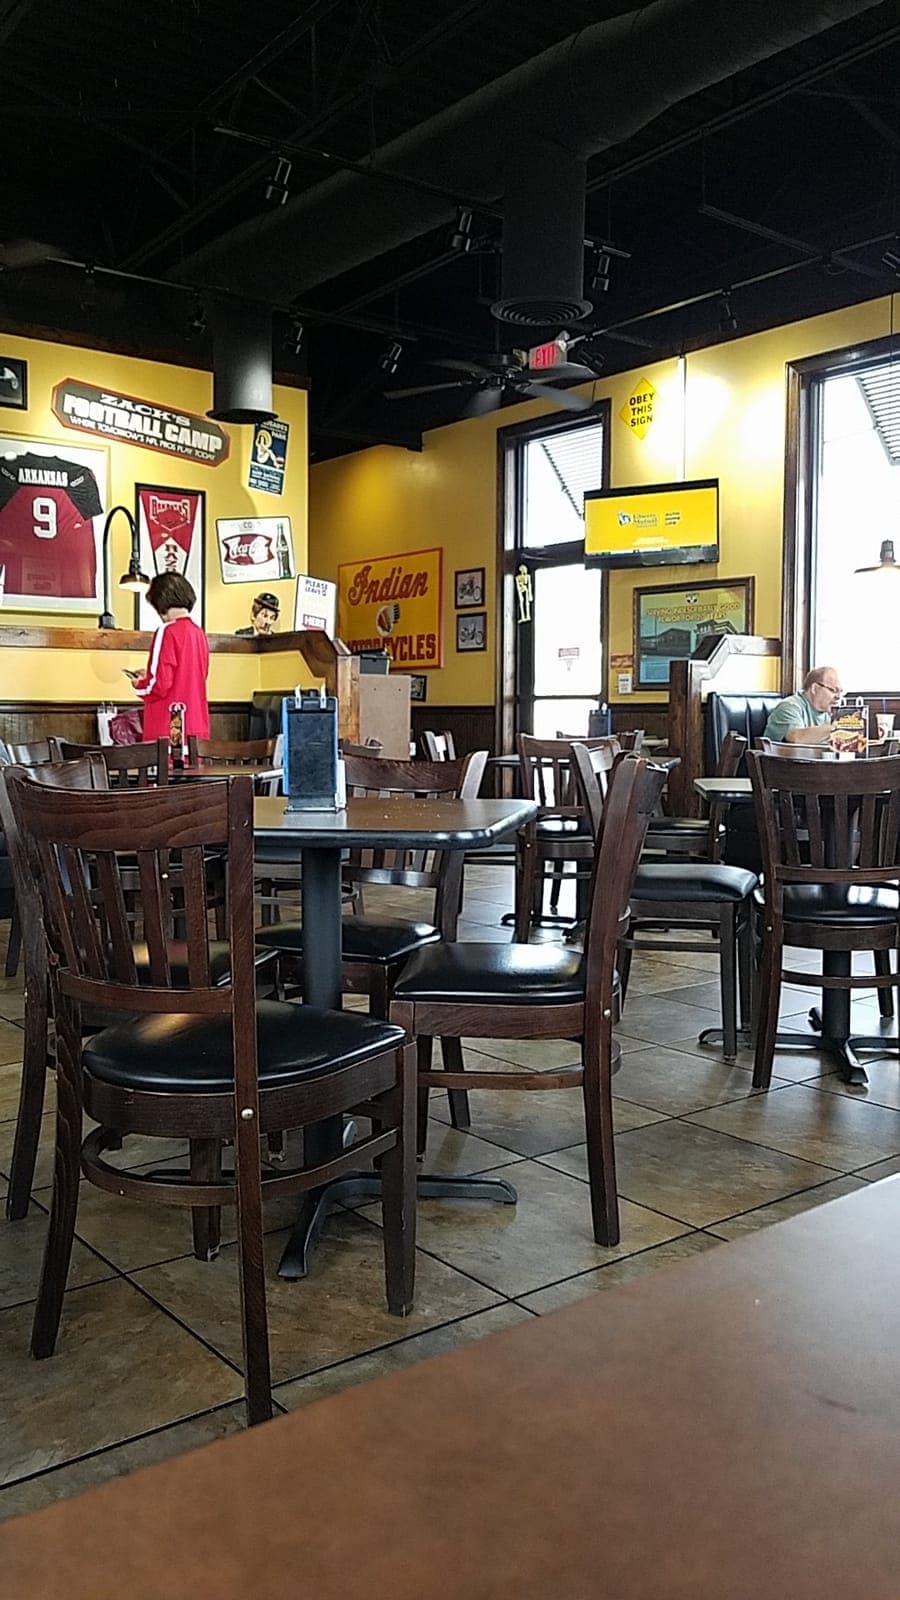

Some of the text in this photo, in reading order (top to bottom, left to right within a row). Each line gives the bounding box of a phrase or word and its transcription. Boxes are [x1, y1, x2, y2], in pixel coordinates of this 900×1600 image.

[534, 342, 557, 371] EXIT
[100, 393, 191, 427] ZACK'S
[629, 392, 655, 406] OBEY
[631, 403, 653, 416] THIS
[63, 393, 223, 453] FOOTBALL CAMP
[630, 414, 653, 428] SIGN
[69, 415, 97, 430] WHERE
[194, 448, 216, 461] TODAY
[18, 467, 69, 487] ARKANSAS
[32, 496, 58, 539] 9
[305, 579, 328, 590] PLEASE
[348, 565, 429, 606] Indian
